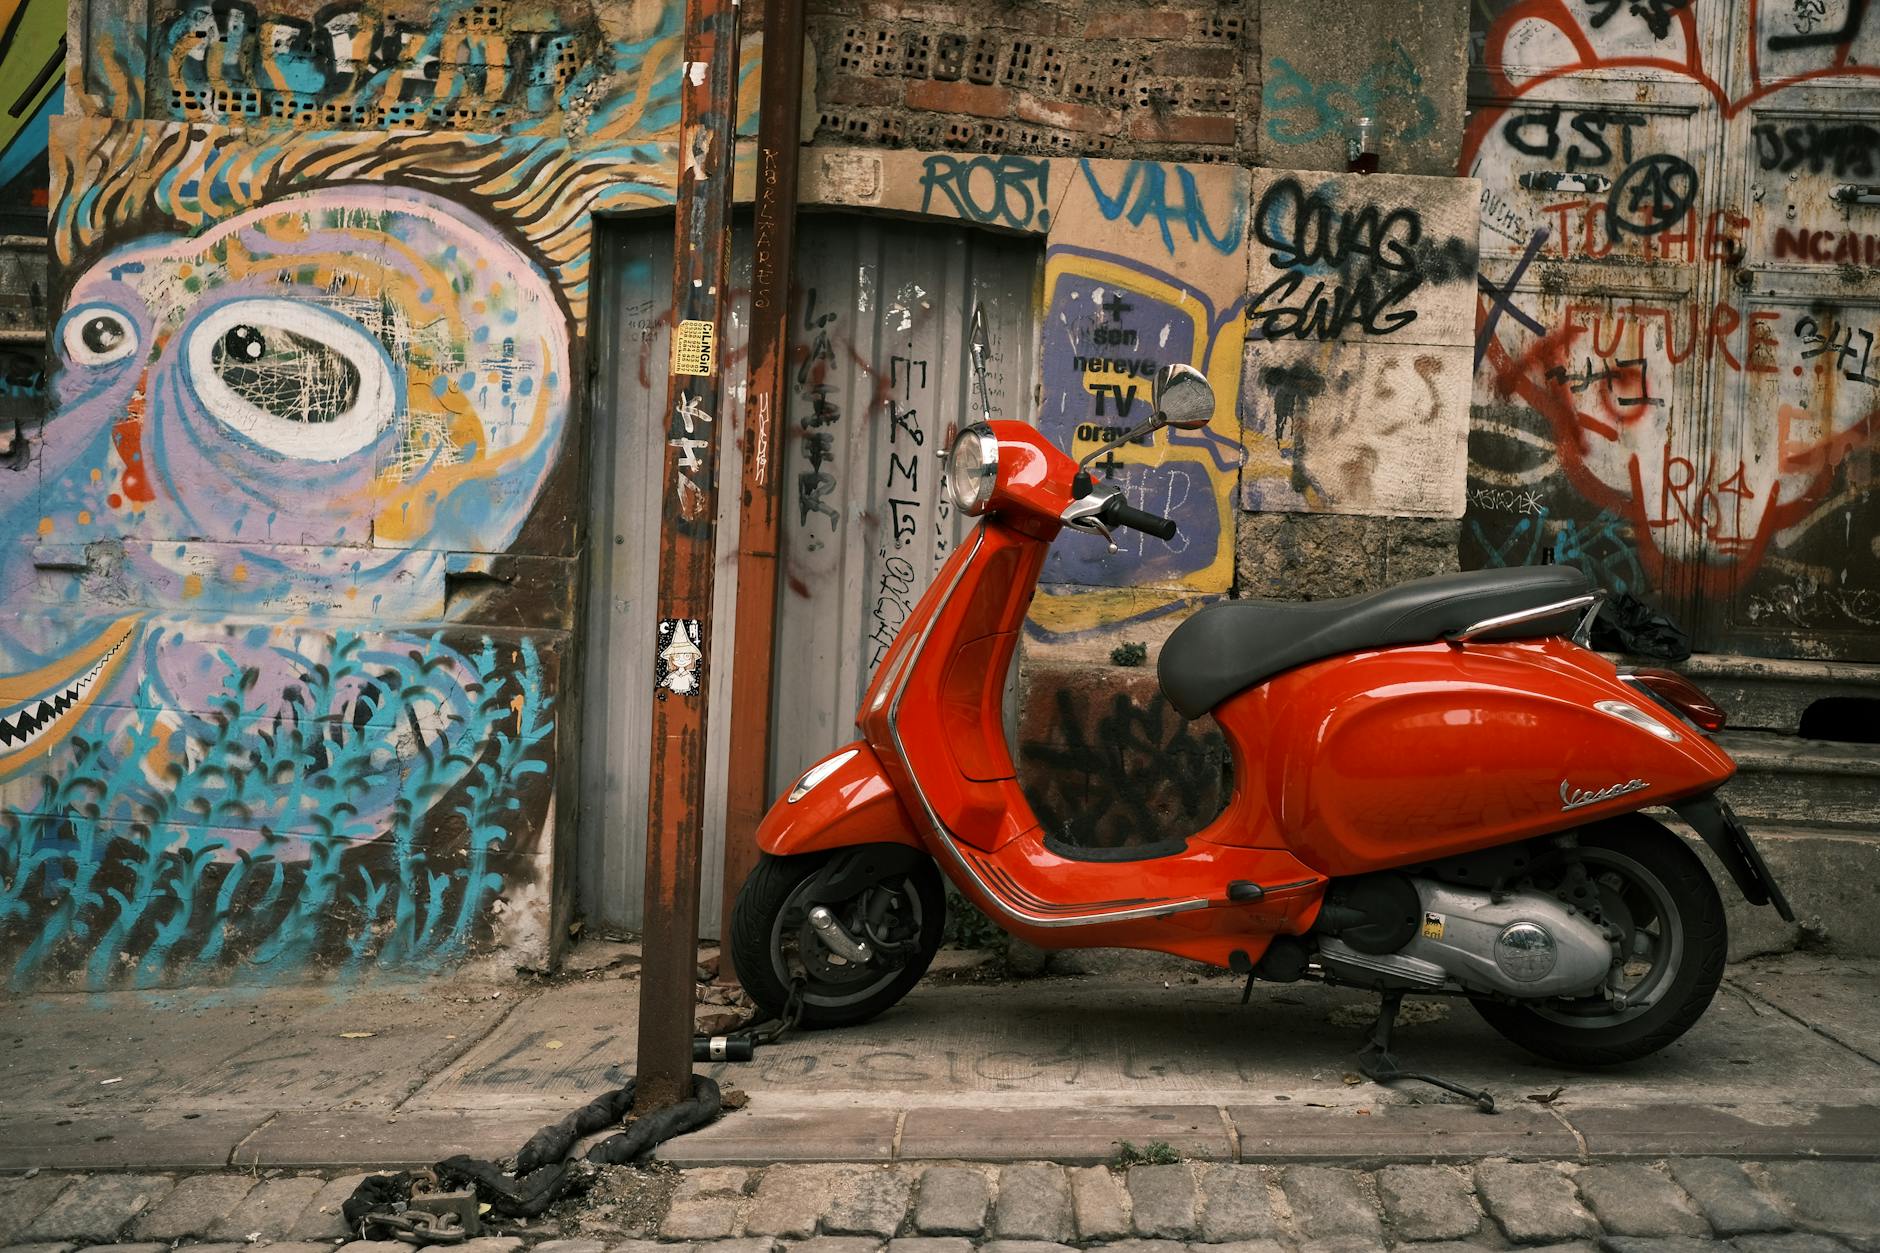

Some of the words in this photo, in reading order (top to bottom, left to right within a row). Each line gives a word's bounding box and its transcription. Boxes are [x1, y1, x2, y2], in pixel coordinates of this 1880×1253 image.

[919, 154, 1049, 233] ROB!
[1543, 200, 1614, 259] TO
[1089, 384, 1137, 417] TV
[1560, 779, 1650, 811] Vespa
[1423, 929, 1441, 939] eni
